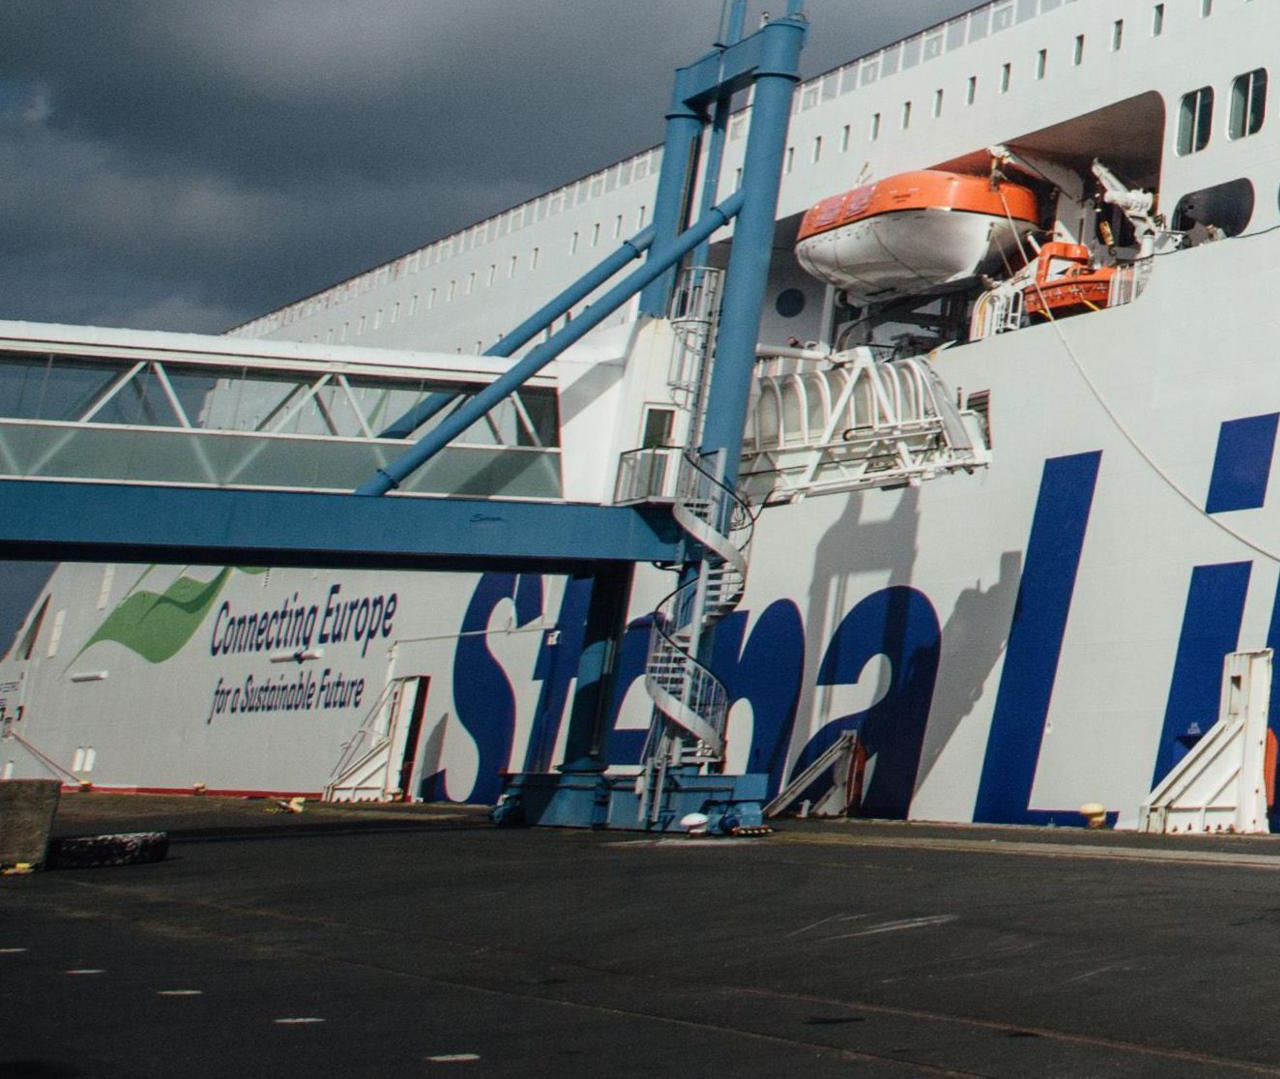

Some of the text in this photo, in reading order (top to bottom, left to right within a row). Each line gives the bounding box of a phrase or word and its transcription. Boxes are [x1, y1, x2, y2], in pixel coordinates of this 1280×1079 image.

[210, 584, 398, 664] Connecting Europe
[207, 668, 365, 725] for a Sustainable Future
